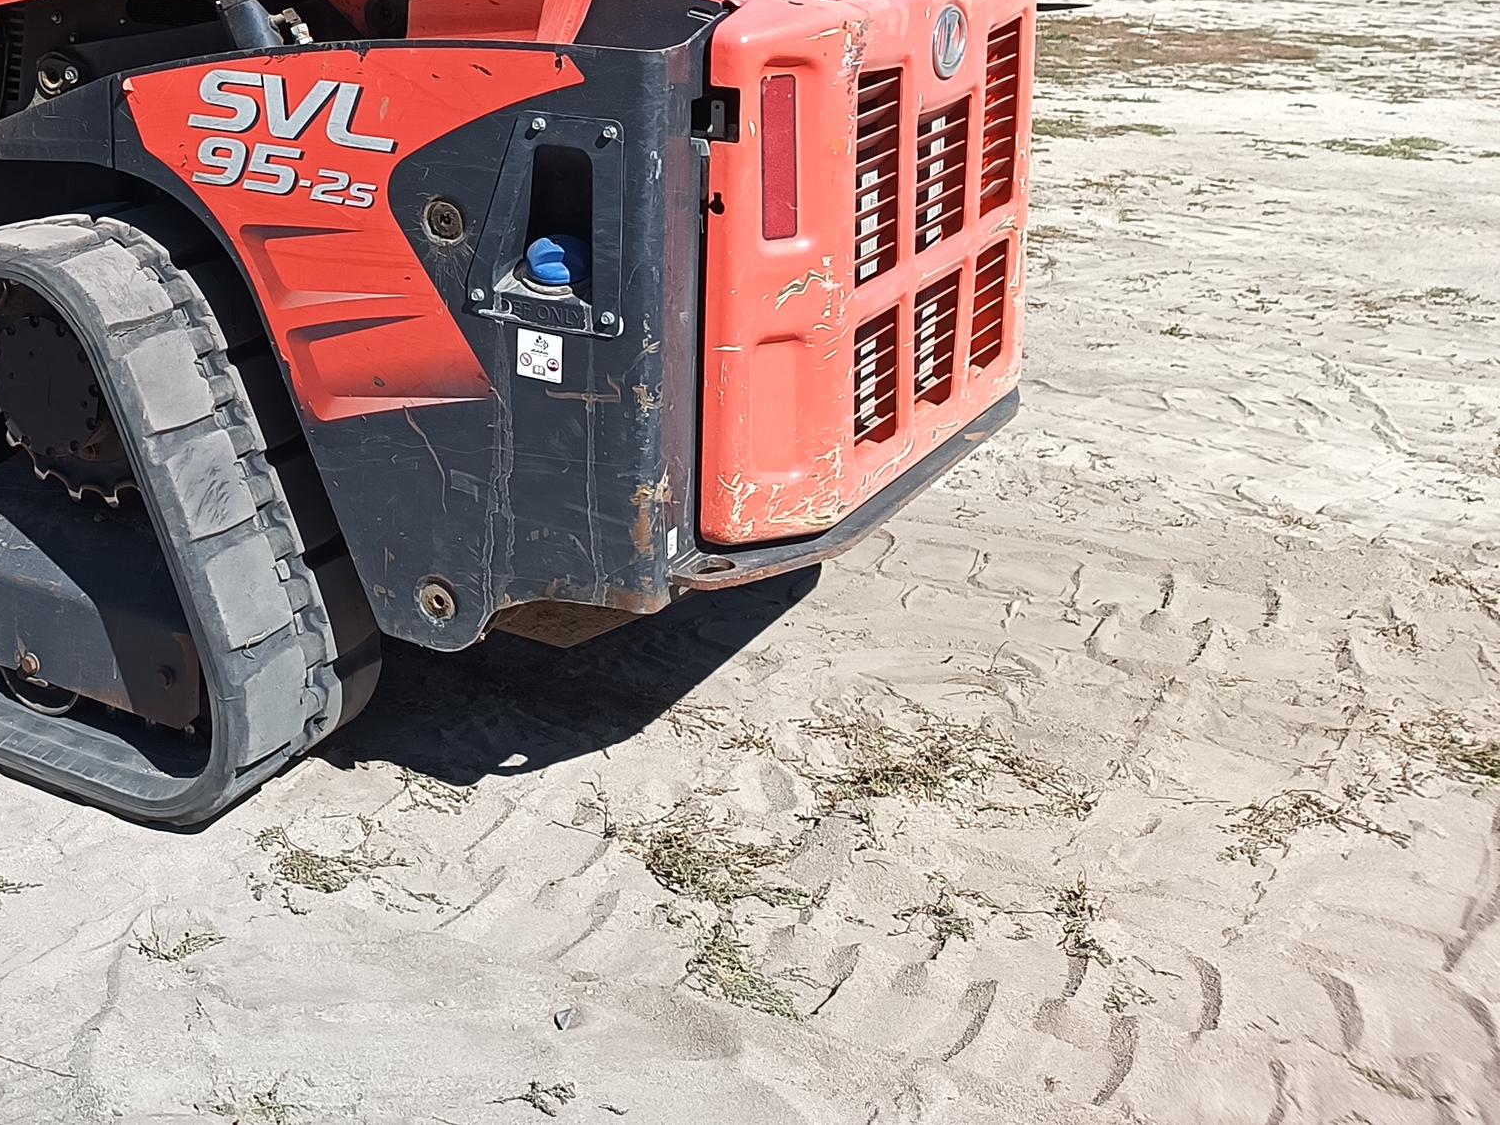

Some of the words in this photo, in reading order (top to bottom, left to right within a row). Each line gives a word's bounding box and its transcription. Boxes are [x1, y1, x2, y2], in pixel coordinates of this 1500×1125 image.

[187, 69, 396, 153] SVL
[500, 297, 533, 317] DEF
[536, 304, 584, 327] ONLY
